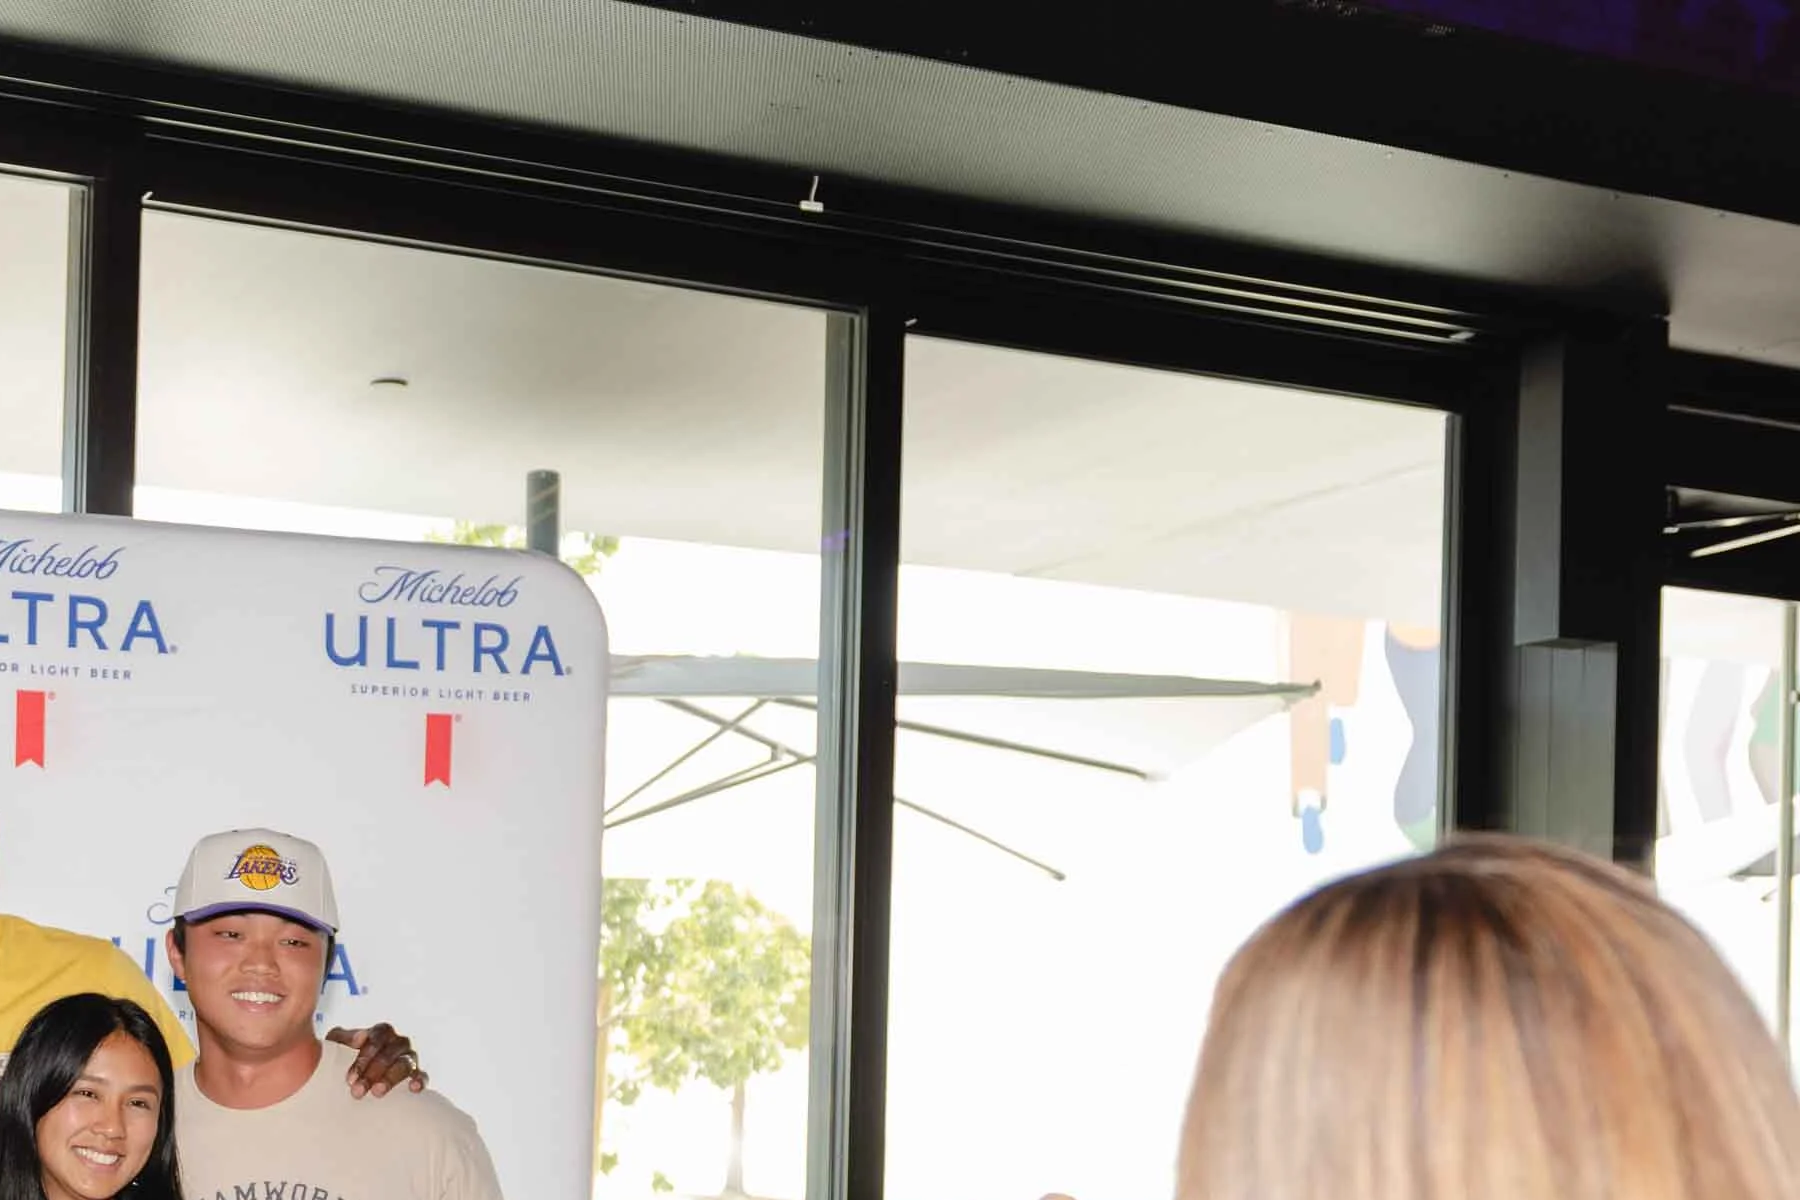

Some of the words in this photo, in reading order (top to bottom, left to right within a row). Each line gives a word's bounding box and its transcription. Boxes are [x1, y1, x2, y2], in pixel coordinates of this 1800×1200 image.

[359, 566, 525, 607] Michelob
[325, 613, 564, 676] ULTRA
[31, 665, 79, 677] LIGHT
[91, 668, 132, 680] BEER
[351, 684, 429, 697] SUPERIOR
[439, 689, 483, 701] LIGHT
[493, 692, 531, 701] BEER
[224, 854, 299, 885] LAKERS
